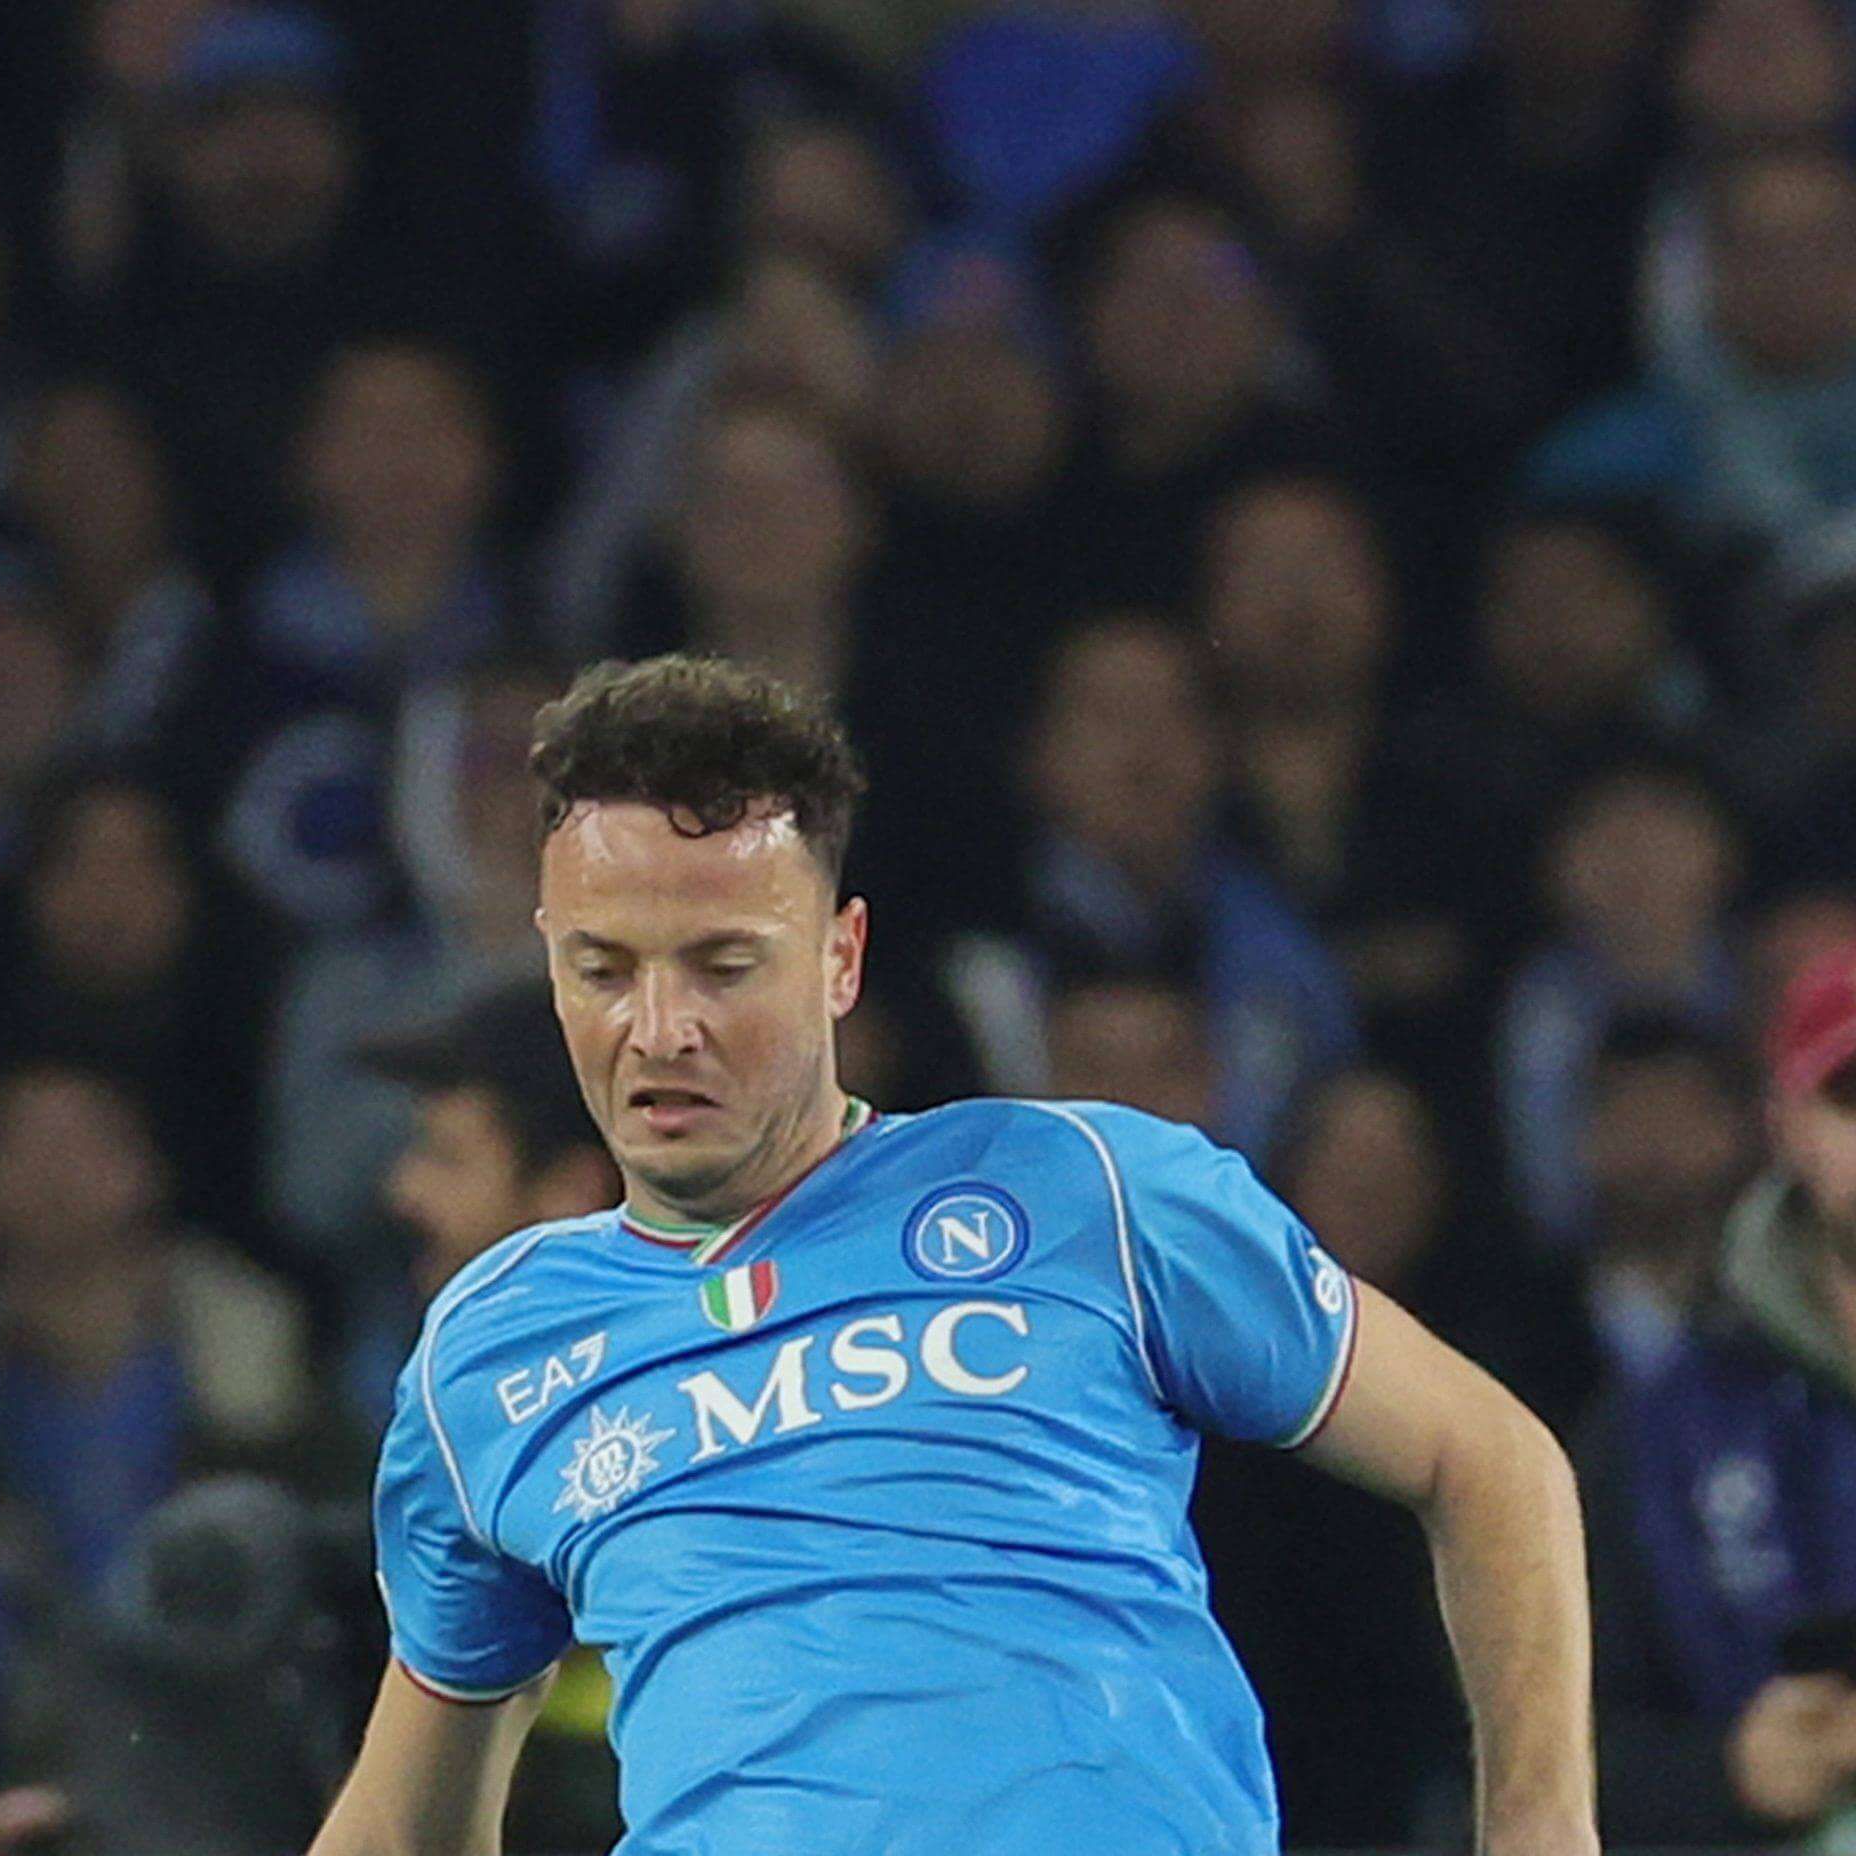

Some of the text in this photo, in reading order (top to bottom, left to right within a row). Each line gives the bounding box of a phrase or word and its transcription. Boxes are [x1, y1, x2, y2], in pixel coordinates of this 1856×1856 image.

[936, 1209, 990, 1264] N
[495, 1331, 607, 1425] EA7
[676, 1301, 1030, 1466] MSC
